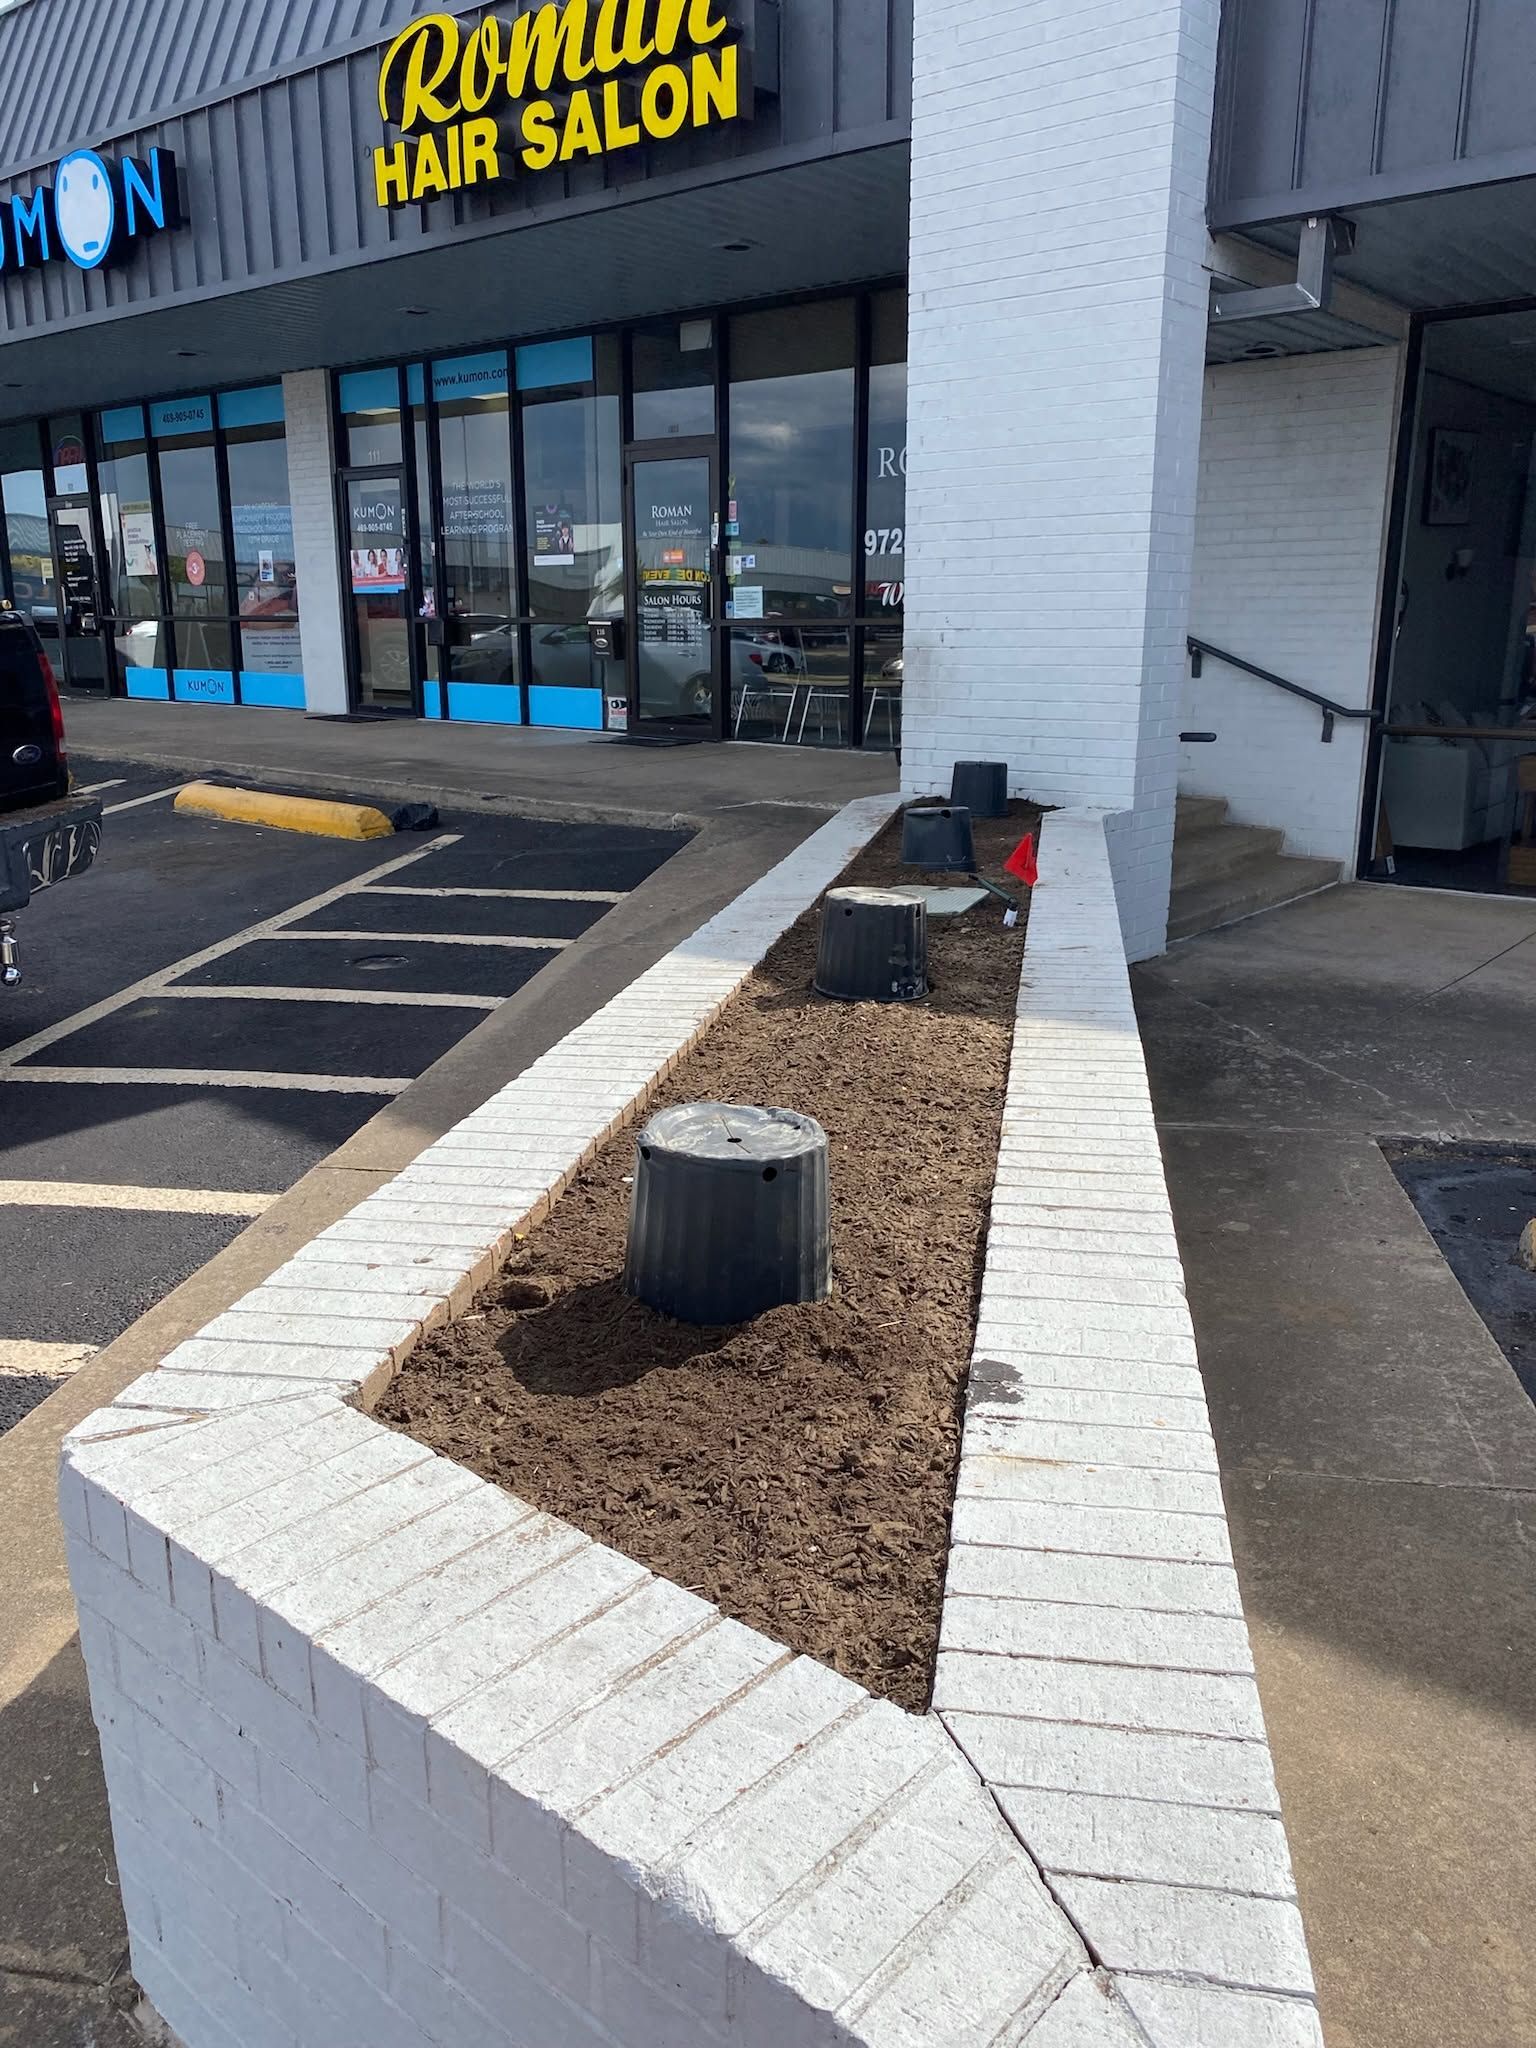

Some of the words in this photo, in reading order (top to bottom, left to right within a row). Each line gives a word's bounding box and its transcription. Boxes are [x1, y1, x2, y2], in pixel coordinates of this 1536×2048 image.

[378, 0, 727, 132] Roman
[373, 117, 500, 207] HAIR
[521, 44, 738, 170] SALON
[0, 146, 165, 270] MON
[452, 482, 466, 491] THE
[443, 496, 462, 506] MOST
[465, 494, 512, 505] SUCCESSFUL
[353, 503, 395, 520] KUMON
[652, 505, 693, 519] ROMAN
[441, 525, 477, 535] LEARNING
[644, 595, 670, 605] SALON
[672, 594, 702, 605] HOURS
[187, 678, 224, 695] KUMON
